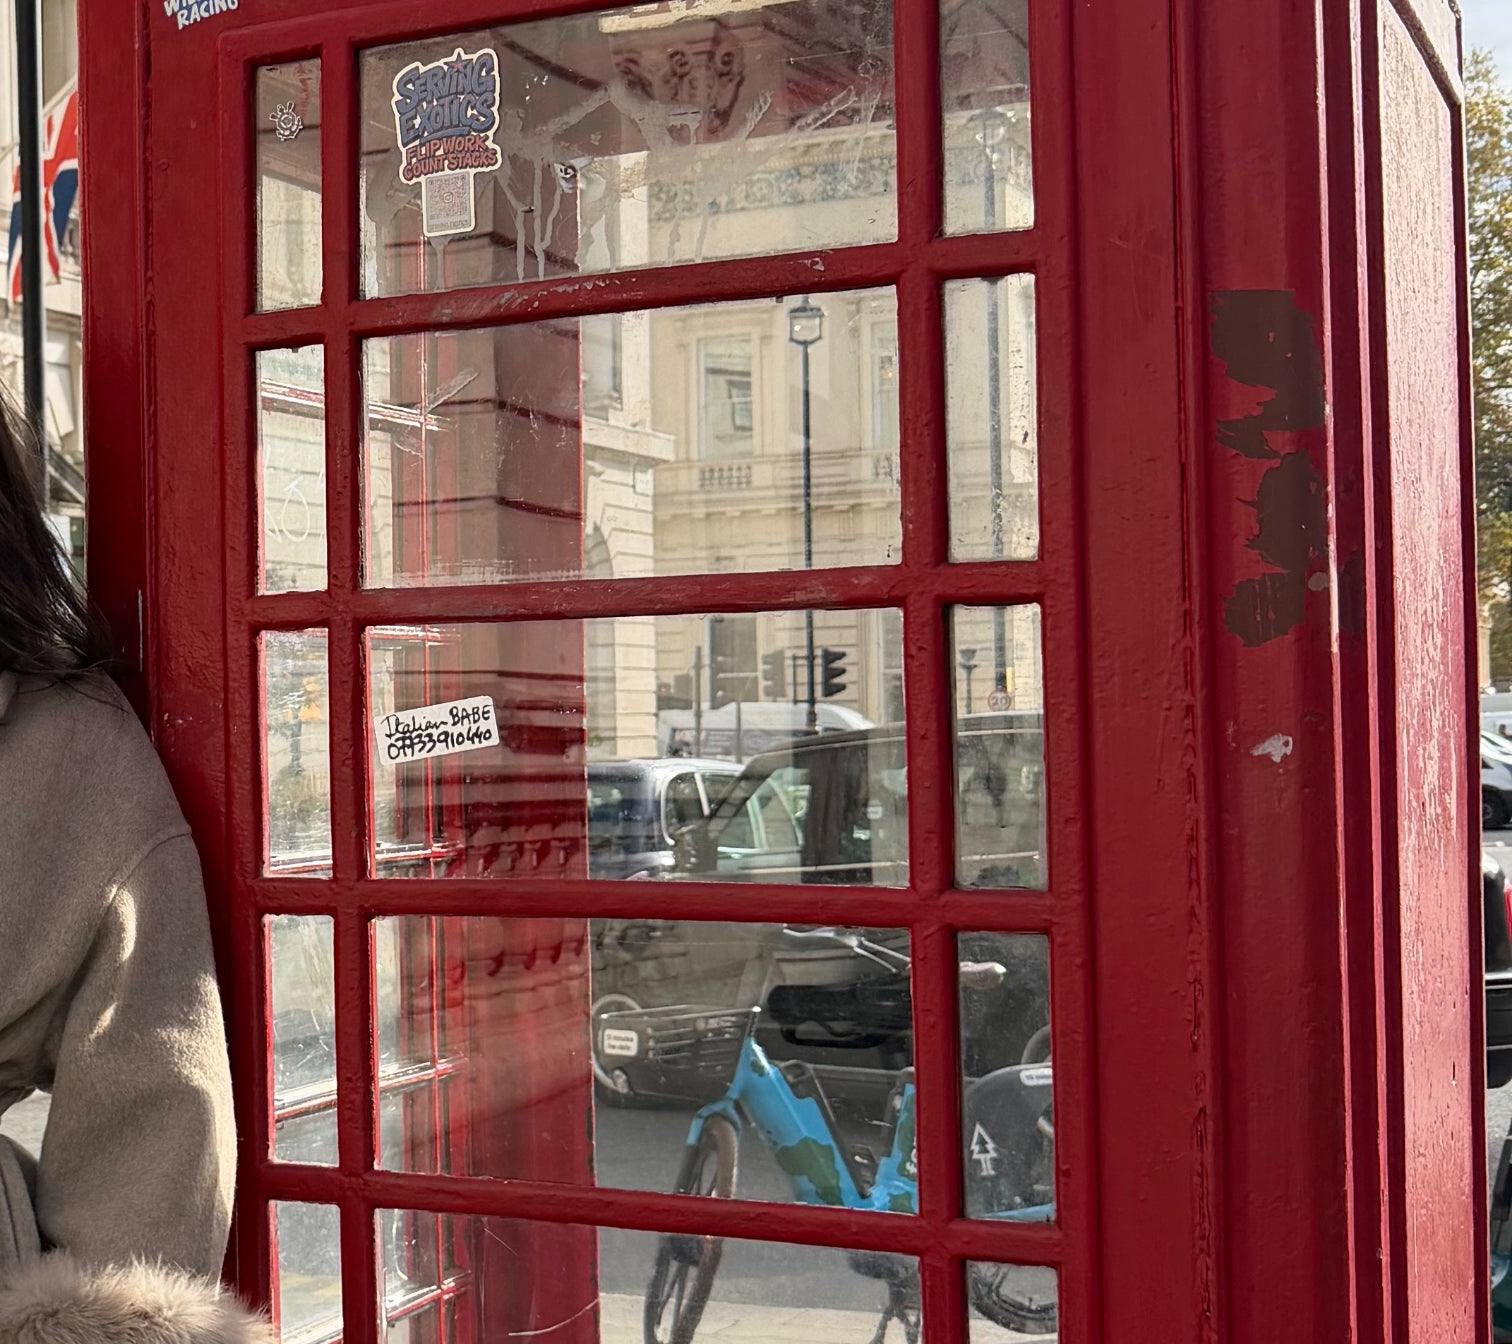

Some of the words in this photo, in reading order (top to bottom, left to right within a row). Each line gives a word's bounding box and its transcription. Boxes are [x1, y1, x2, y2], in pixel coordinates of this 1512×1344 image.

[395, 52, 497, 116] SERVING
[399, 91, 496, 148] EXOTICS
[402, 156, 448, 182] COUNT
[446, 148, 498, 172] STACKS
[406, 139, 441, 165] FLIP
[441, 133, 489, 154] WORK
[991, 696, 1008, 707] 20
[380, 714, 448, 739] Italian
[448, 704, 492, 727] BABE
[387, 726, 492, 760] 07733910440
